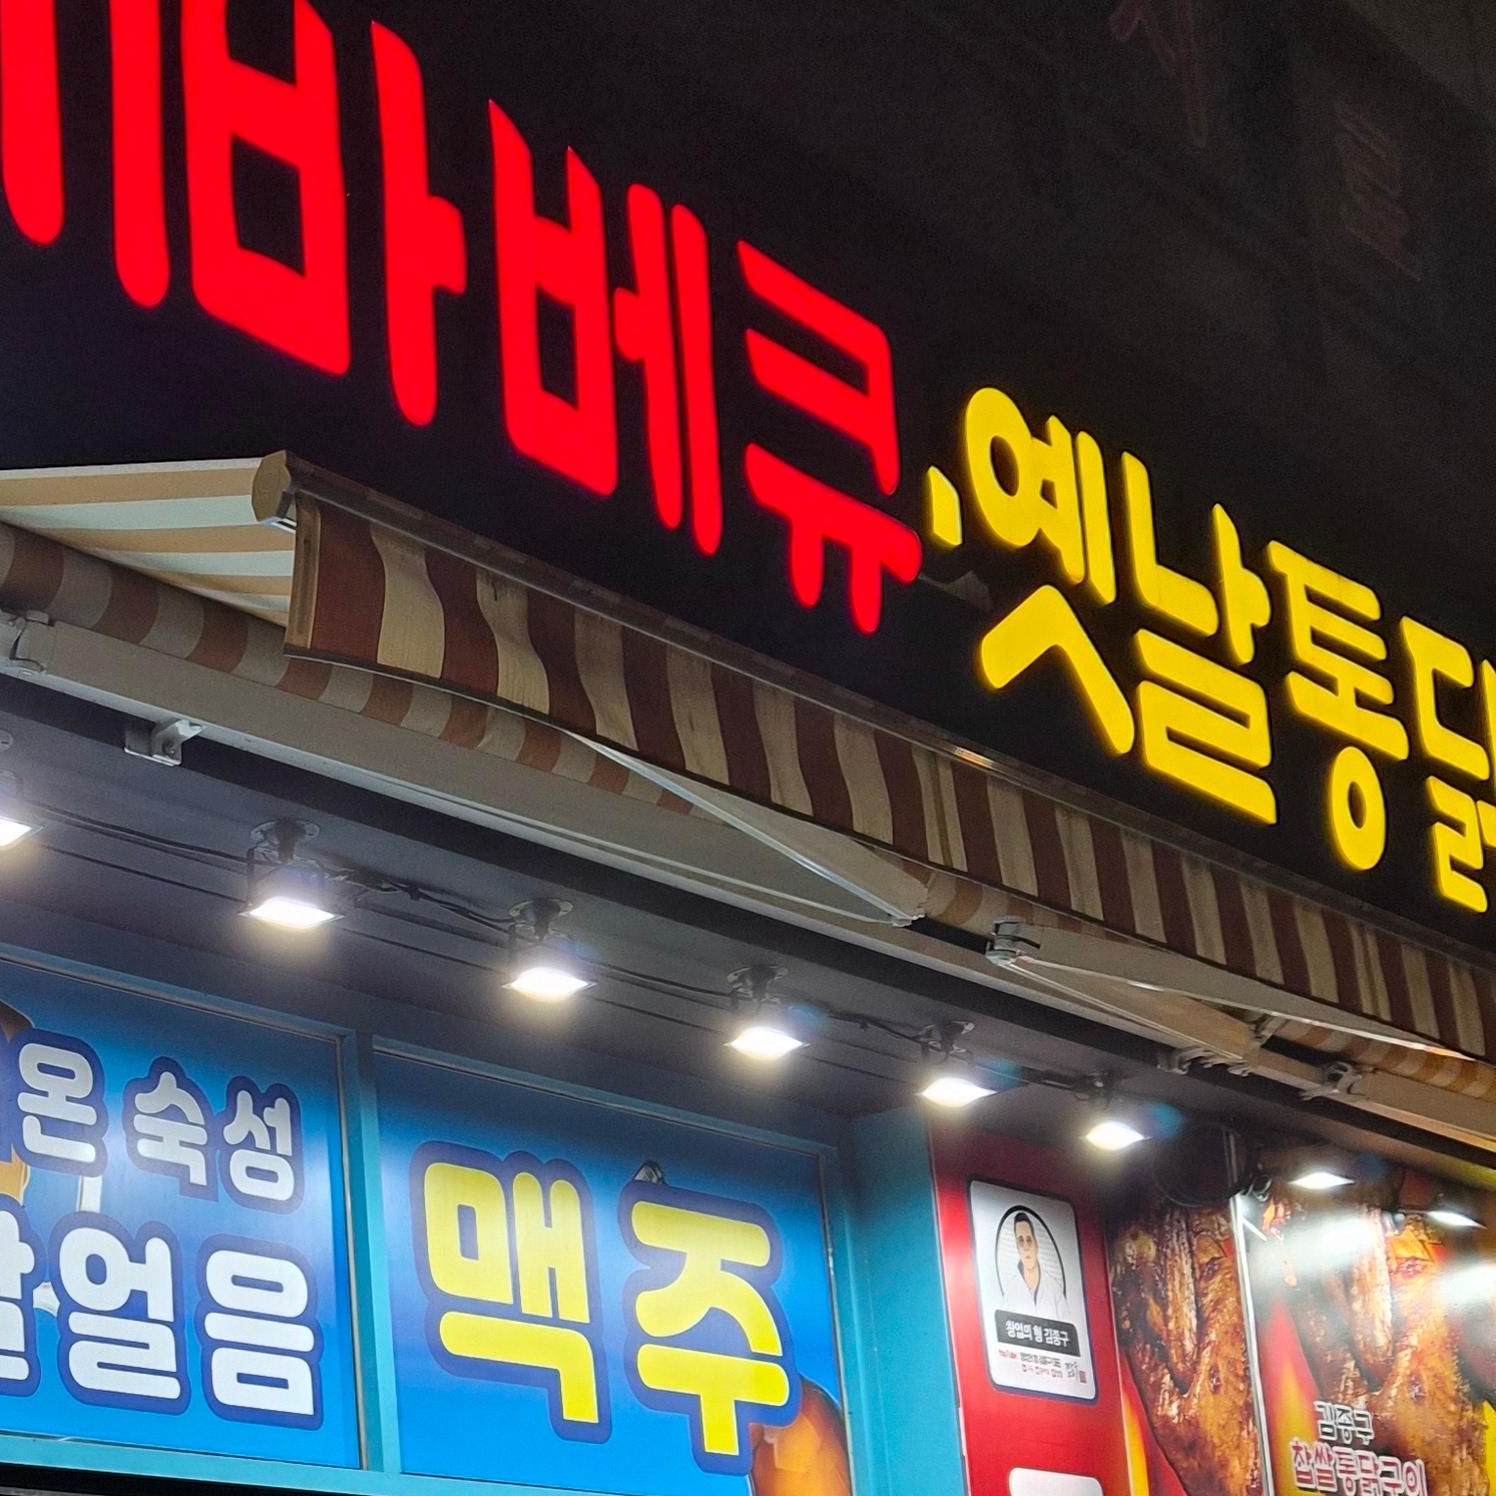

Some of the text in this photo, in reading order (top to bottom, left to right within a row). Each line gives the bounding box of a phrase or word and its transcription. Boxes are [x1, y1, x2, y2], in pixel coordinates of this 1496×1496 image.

[131, 1070, 295, 1202] 숙성
[424, 1160, 791, 1457] 맥주
[1044, 1327, 1070, 1347] 김종구
[1314, 1400, 1374, 1446] 김종구
